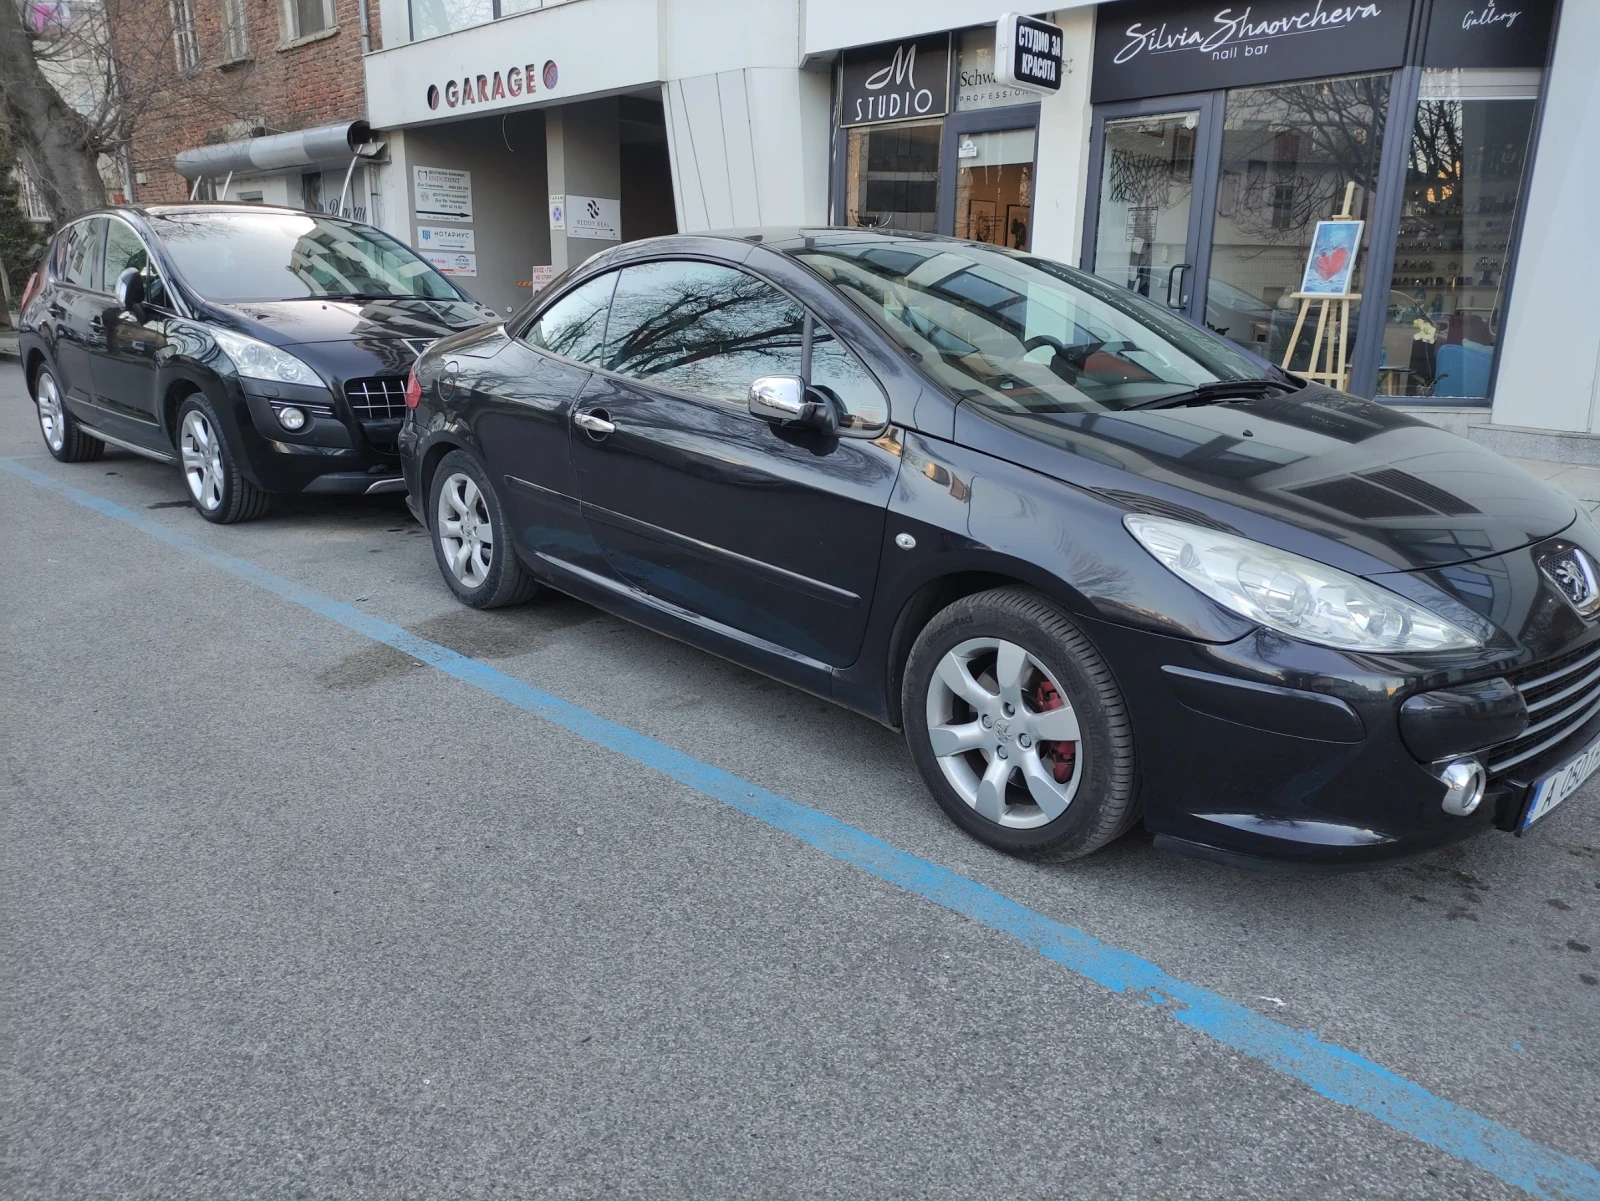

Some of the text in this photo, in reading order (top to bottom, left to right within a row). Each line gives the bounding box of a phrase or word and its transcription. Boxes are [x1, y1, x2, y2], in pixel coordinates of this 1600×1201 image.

[1461, 7, 1522, 30] Gallery
[1018, 25, 1061, 57] СТУДИО ЗА
[1113, 22, 1204, 64] Silvia
[1211, 43, 1270, 61] nail bar
[1021, 52, 1056, 82] КРАСОТА
[445, 63, 537, 108] GARAGE
[855, 88, 933, 121] STUDIO
[434, 230, 470, 239] НОТАРИУС
[597, 220, 610, 228] REAL
[924, 613, 975, 647] UltraContact
[1540, 777, 1557, 812] A
